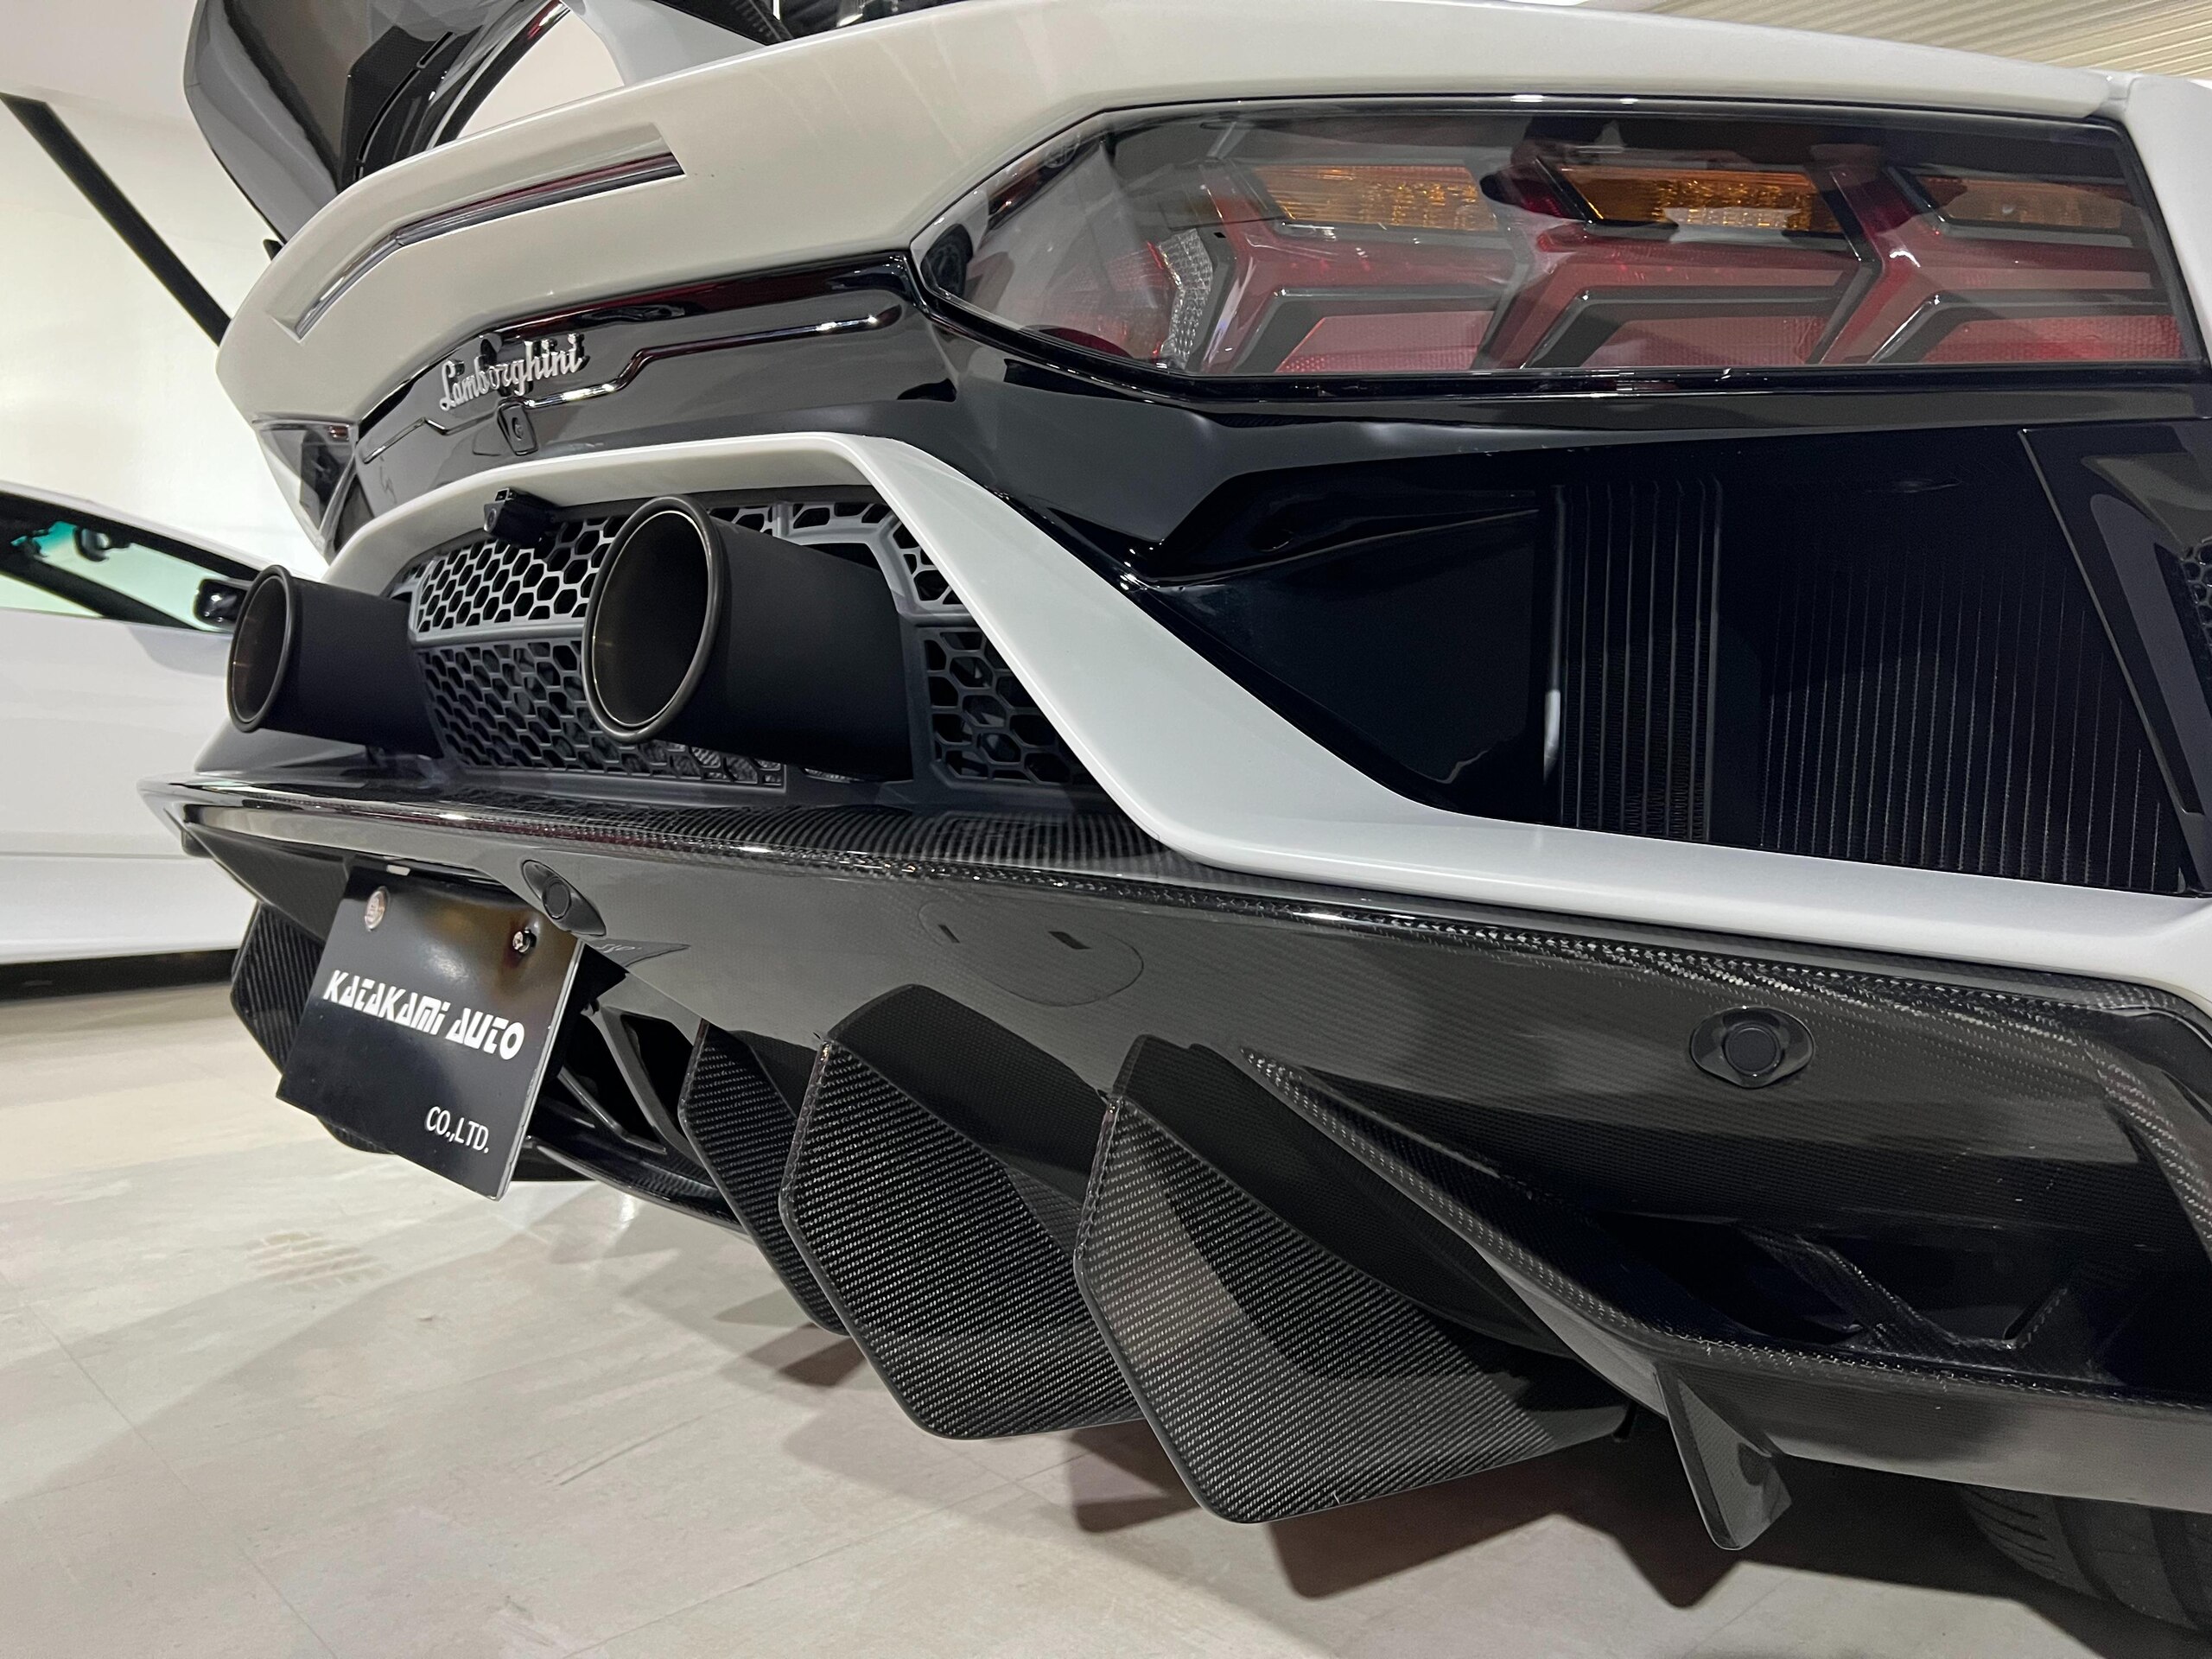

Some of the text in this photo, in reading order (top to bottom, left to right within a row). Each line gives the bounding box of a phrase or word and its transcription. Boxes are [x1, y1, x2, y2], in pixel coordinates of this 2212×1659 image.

[440, 333, 583, 411] Lamborghini
[445, 1007, 524, 1060] AUTO
[426, 1106, 489, 1154] CO.,LTD.
